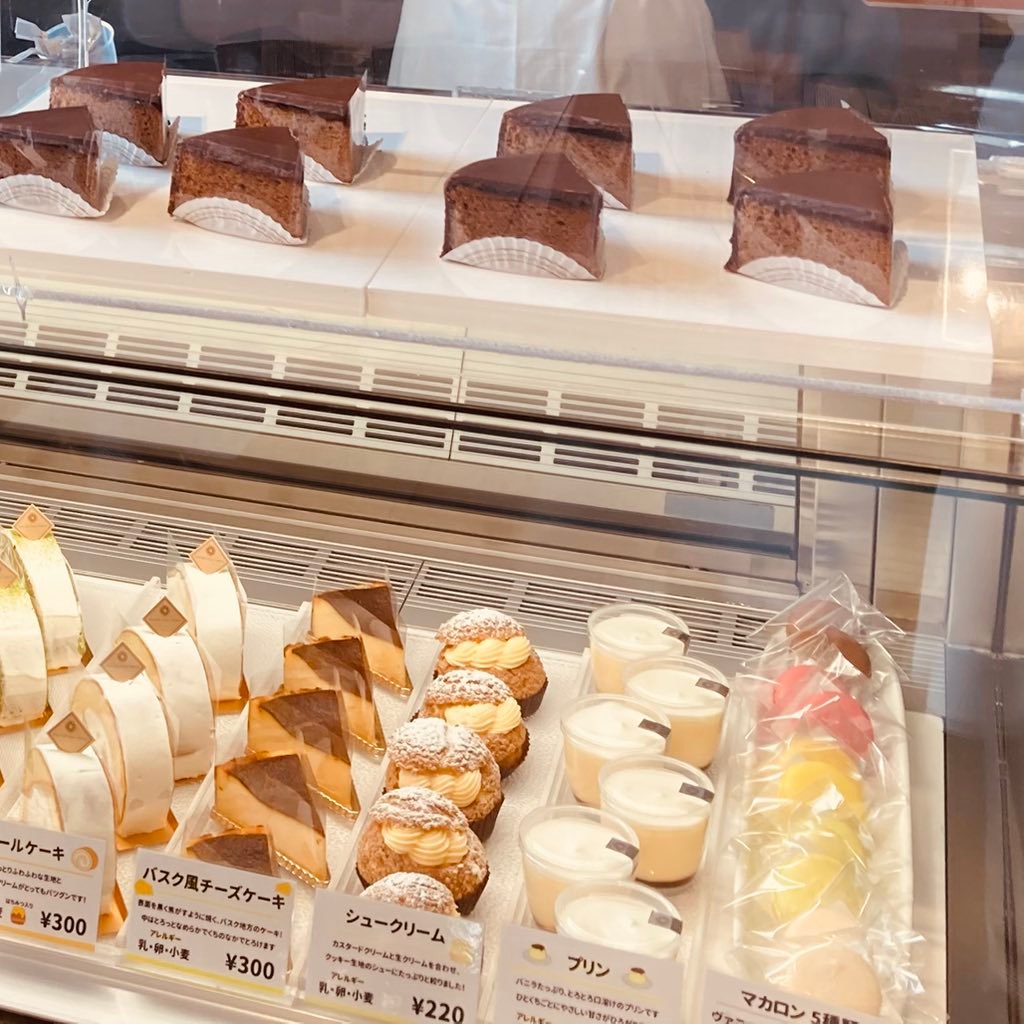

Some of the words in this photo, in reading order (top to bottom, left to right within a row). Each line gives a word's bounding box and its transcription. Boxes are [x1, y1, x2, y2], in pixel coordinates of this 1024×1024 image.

[143, 867, 285, 910] バスク風チーズケーキ
[40, 911, 87, 936] ¥300
[150, 929, 182, 942] アレルギー
[346, 909, 446, 944] シュークリーム
[138, 938, 190, 961] 乳・卵・小麦
[225, 953, 275, 980] ¥300
[331, 971, 364, 985] アレルギー
[568, 955, 610, 977] プリン
[319, 981, 374, 1005] 乳・卵・小麦
[741, 990, 805, 1019] マカロン
[412, 996, 465, 1024] ¥220
